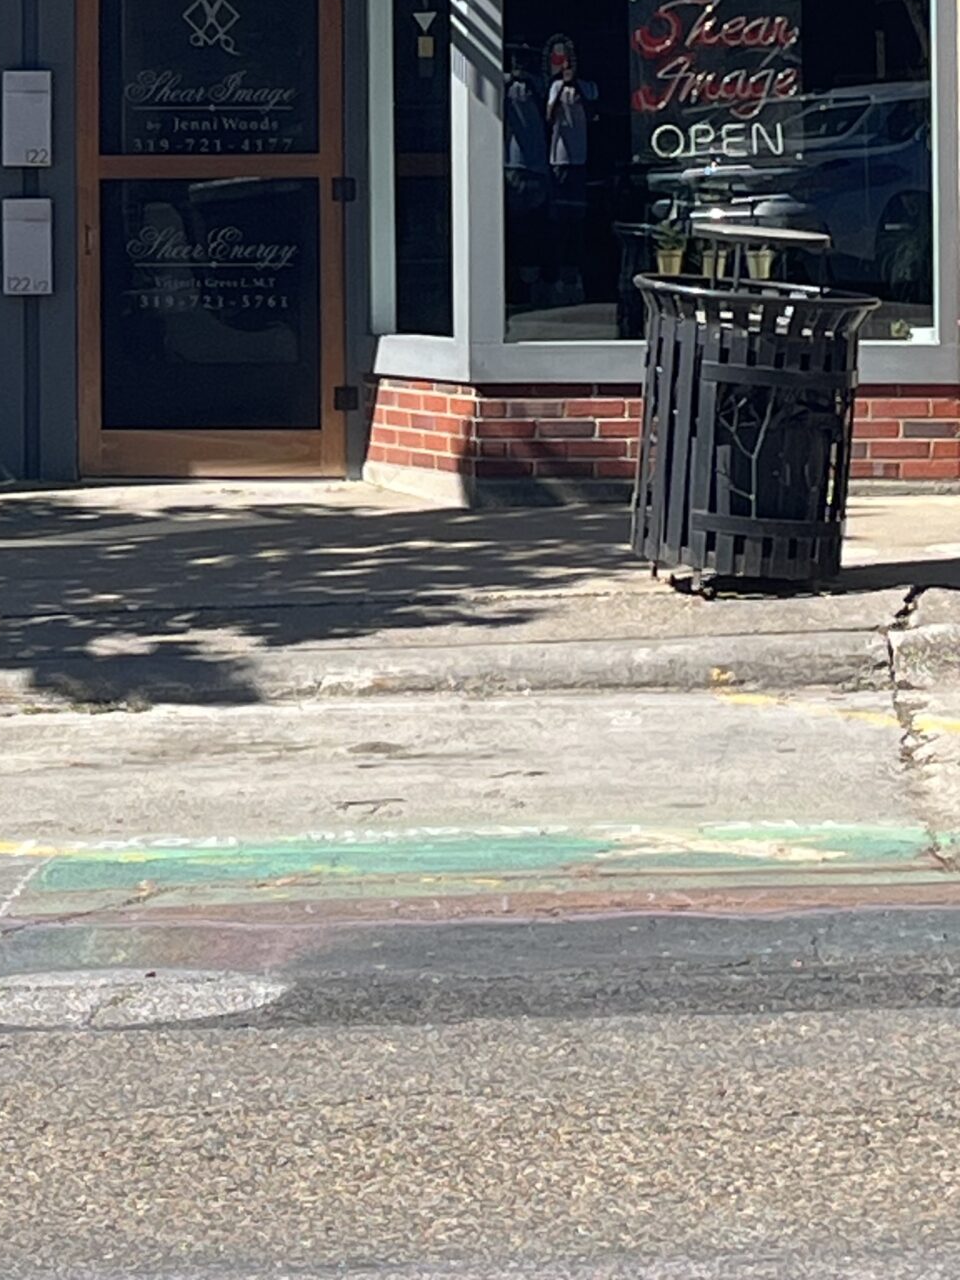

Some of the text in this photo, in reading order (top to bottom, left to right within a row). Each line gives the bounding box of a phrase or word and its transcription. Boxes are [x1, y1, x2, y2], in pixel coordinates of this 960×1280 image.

[124, 70, 298, 114] Shear Image
[633, 55, 798, 119] Image
[173, 117, 218, 132] Jenni
[221, 117, 279, 131] Woods
[132, 138, 294, 152] 319-721-4177
[650, 122, 784, 159] OPEN
[25, 148, 49, 164] 122
[125, 225, 298, 270] Sheer Energy
[7, 276, 31, 292] 122
